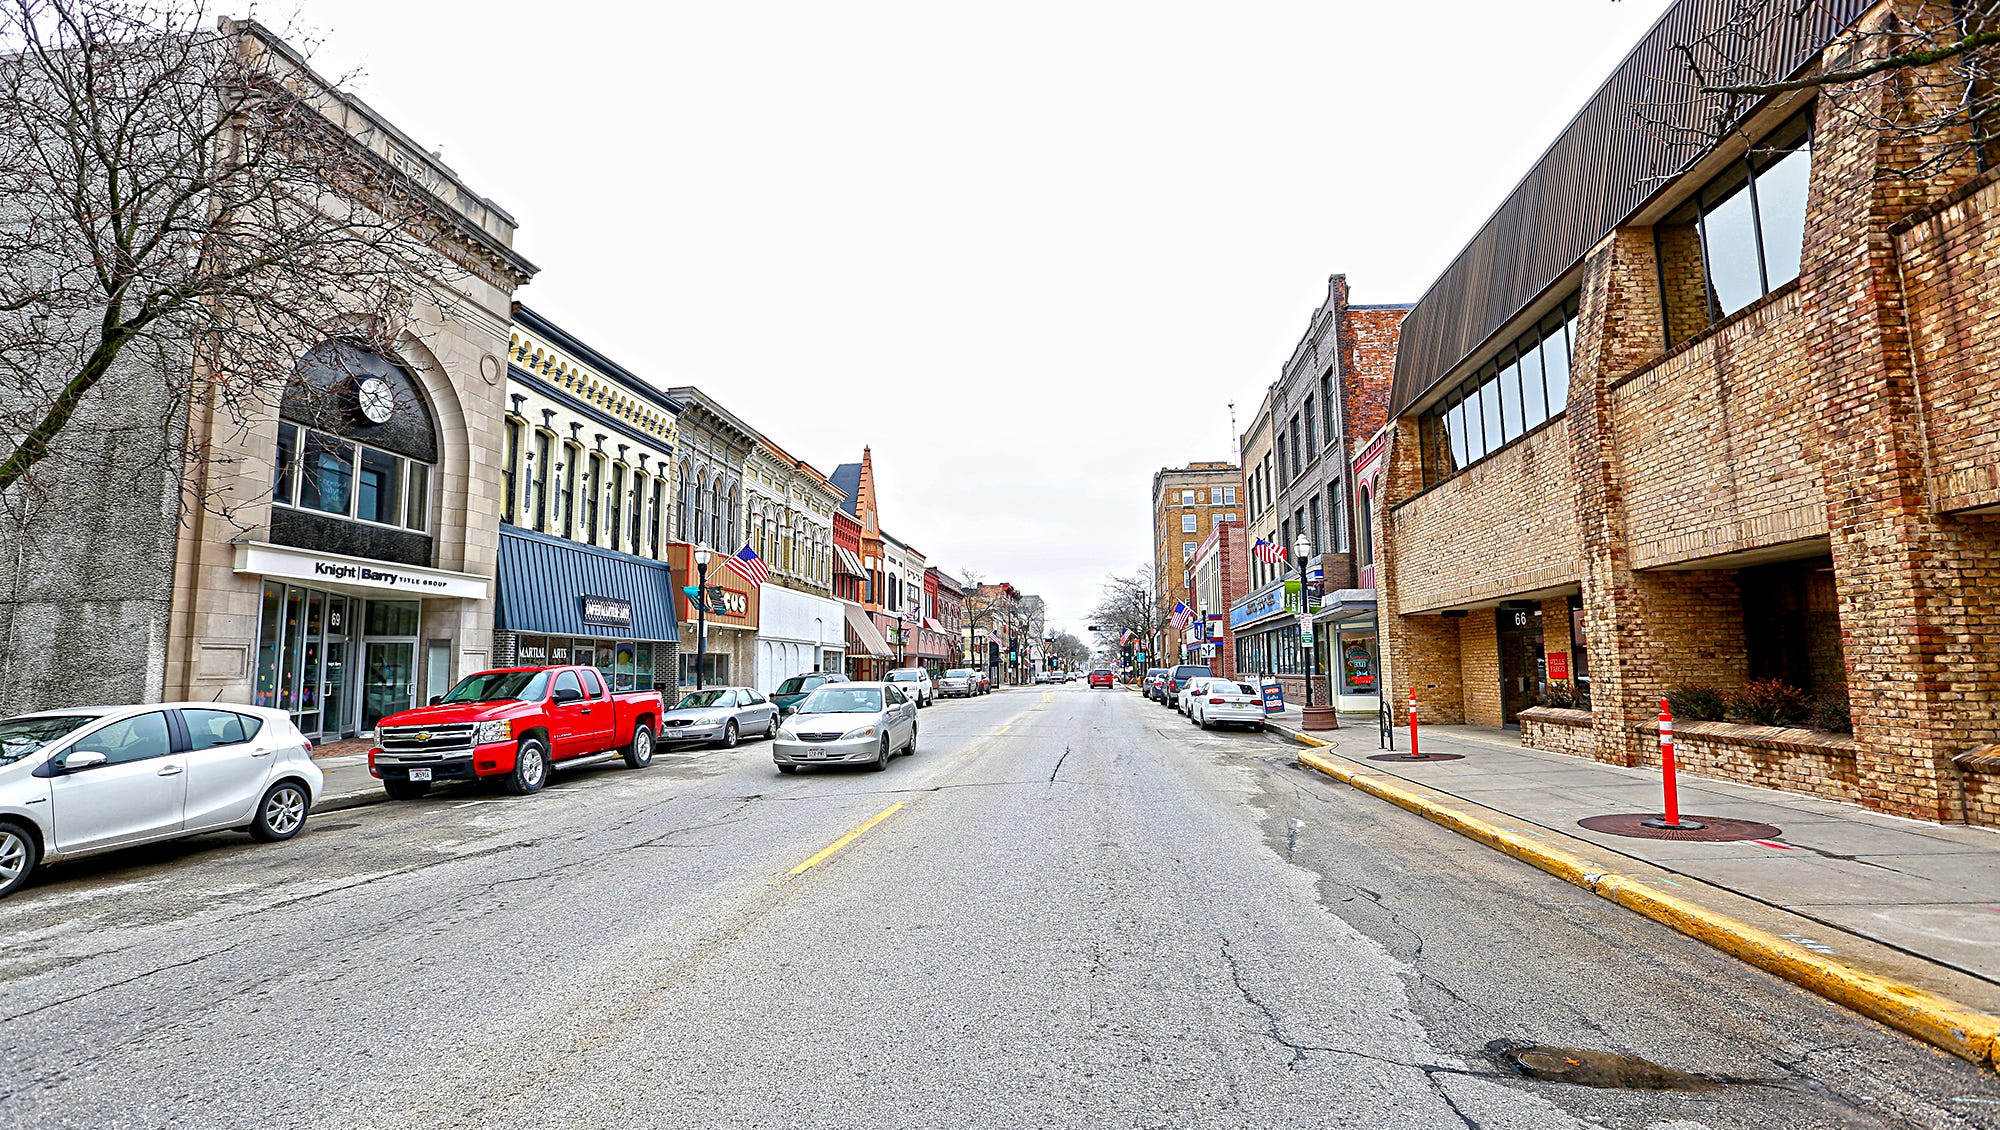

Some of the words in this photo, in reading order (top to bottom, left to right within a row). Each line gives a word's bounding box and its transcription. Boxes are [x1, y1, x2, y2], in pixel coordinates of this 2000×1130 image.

[315, 562, 356, 579] Knight
[361, 568, 398, 585] Barry
[399, 576, 420, 585] TITLE
[422, 579, 448, 587] GROUP
[331, 612, 341, 626] 69
[1515, 612, 1527, 626] 66
[552, 647, 568, 659] ARTS
[1549, 658, 1566, 666] WELLS
[1550, 665, 1566, 673] FARGO
